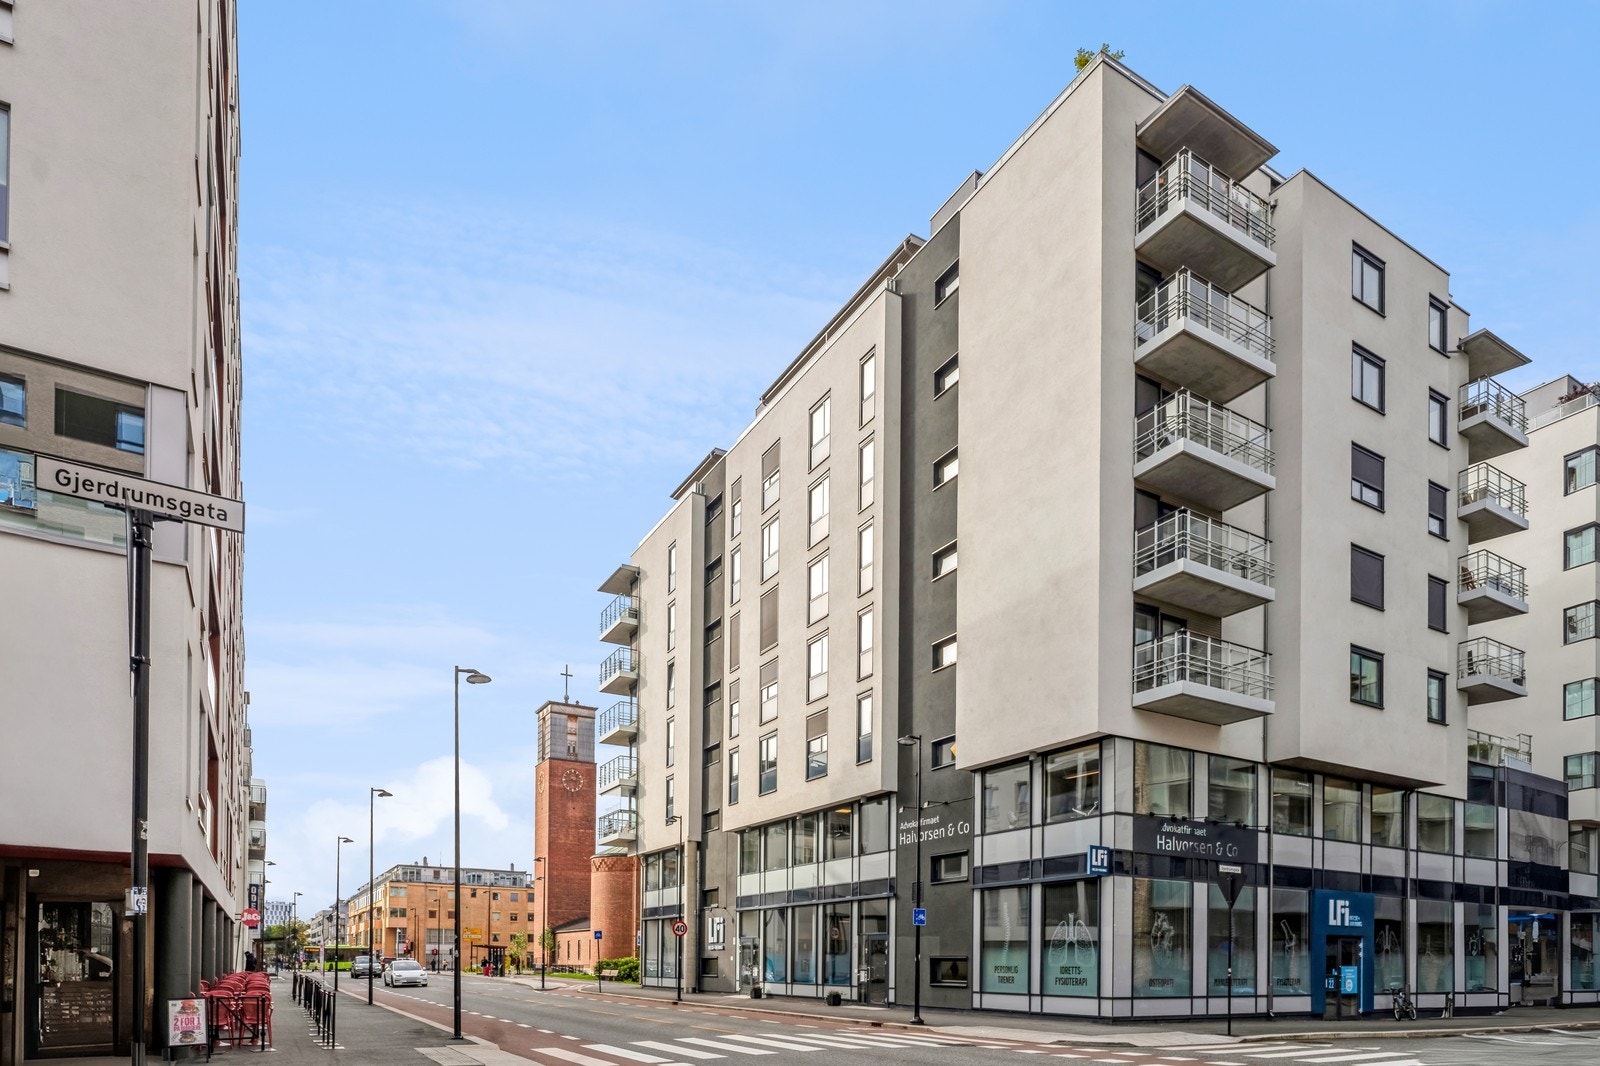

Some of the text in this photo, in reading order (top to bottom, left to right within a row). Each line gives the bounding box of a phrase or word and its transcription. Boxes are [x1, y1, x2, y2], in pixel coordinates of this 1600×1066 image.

[55, 468, 228, 522] Gjerdrumsgata
[899, 815, 940, 830] Advokafirmaet
[947, 823, 955, 837] &
[957, 821, 970, 835] Co
[1156, 834, 1238, 857] Halvorsen & Co
[675, 924, 685, 933] 40
[997, 975, 1015, 985] TRENER
[1054, 976, 1088, 987] FYSIOTERAPI
[173, 1017, 180, 1027] 2
[180, 1016, 195, 1026] FOR
